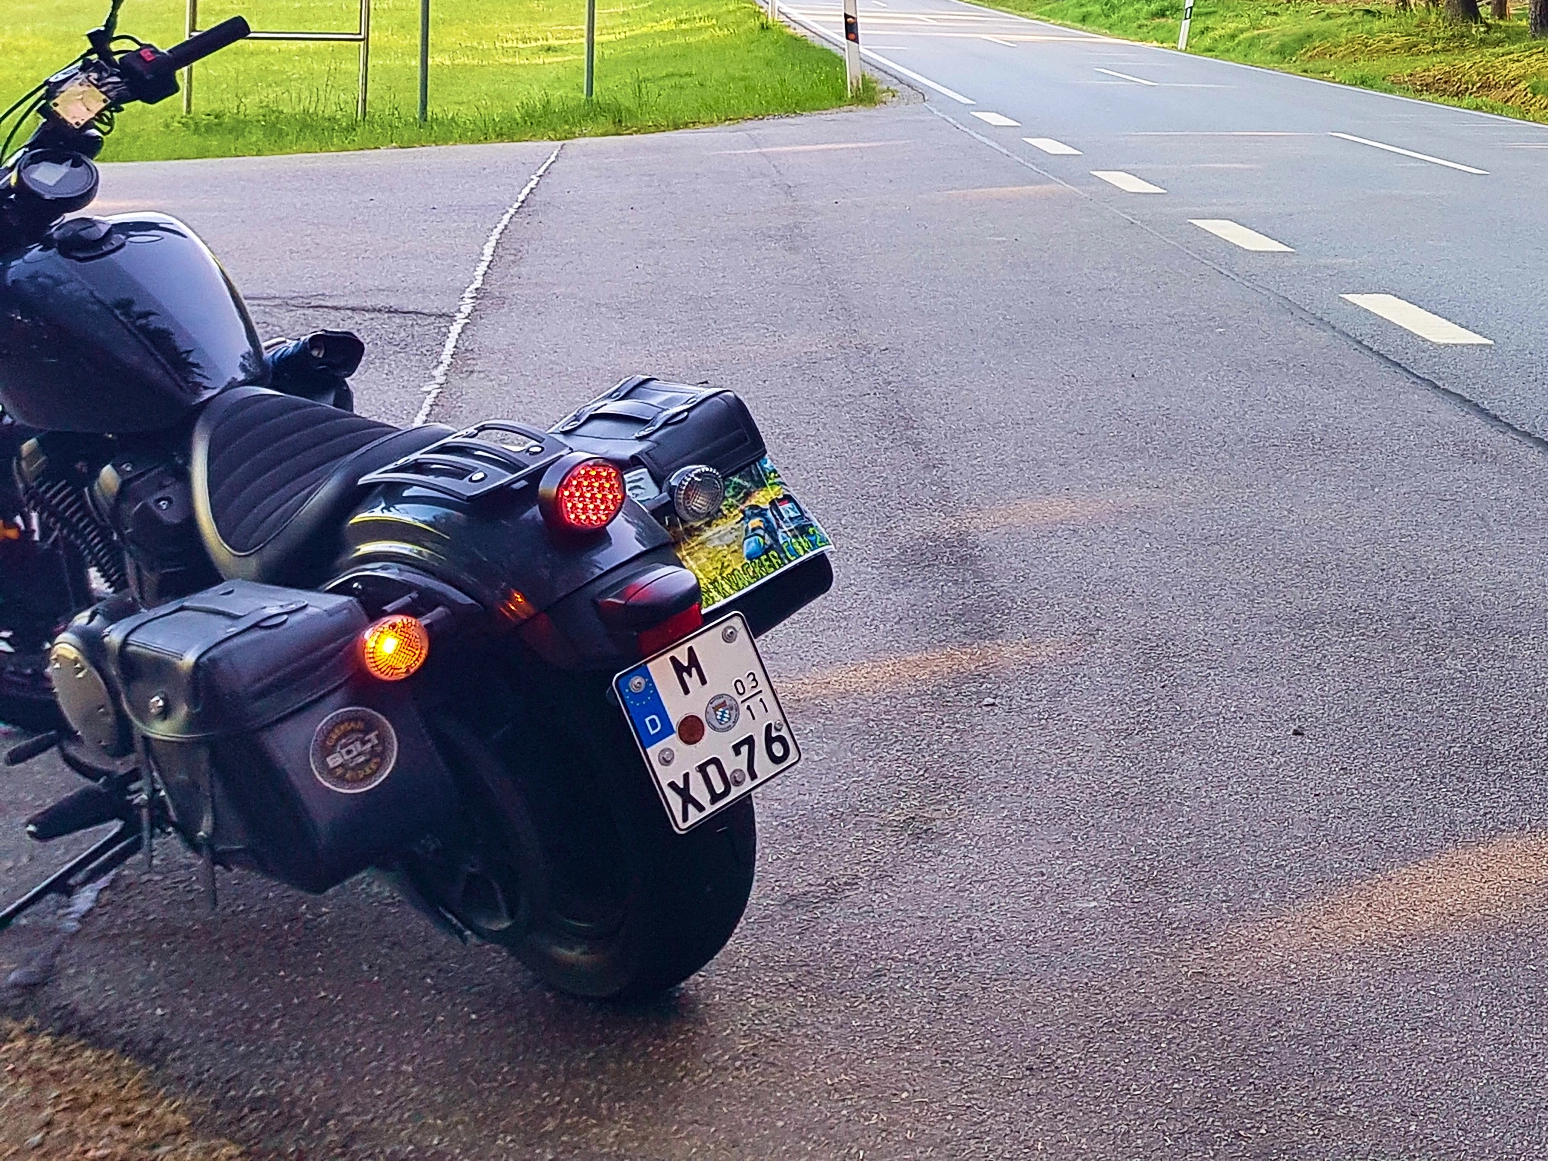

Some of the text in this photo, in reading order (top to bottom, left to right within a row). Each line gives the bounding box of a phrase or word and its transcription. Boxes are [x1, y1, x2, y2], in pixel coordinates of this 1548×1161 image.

[669, 645, 708, 696] M
[733, 671, 759, 696] 03
[645, 714, 662, 735] D
[746, 697, 769, 721] 11
[326, 730, 379, 769] BOLT
[667, 722, 791, 823] XD 76
